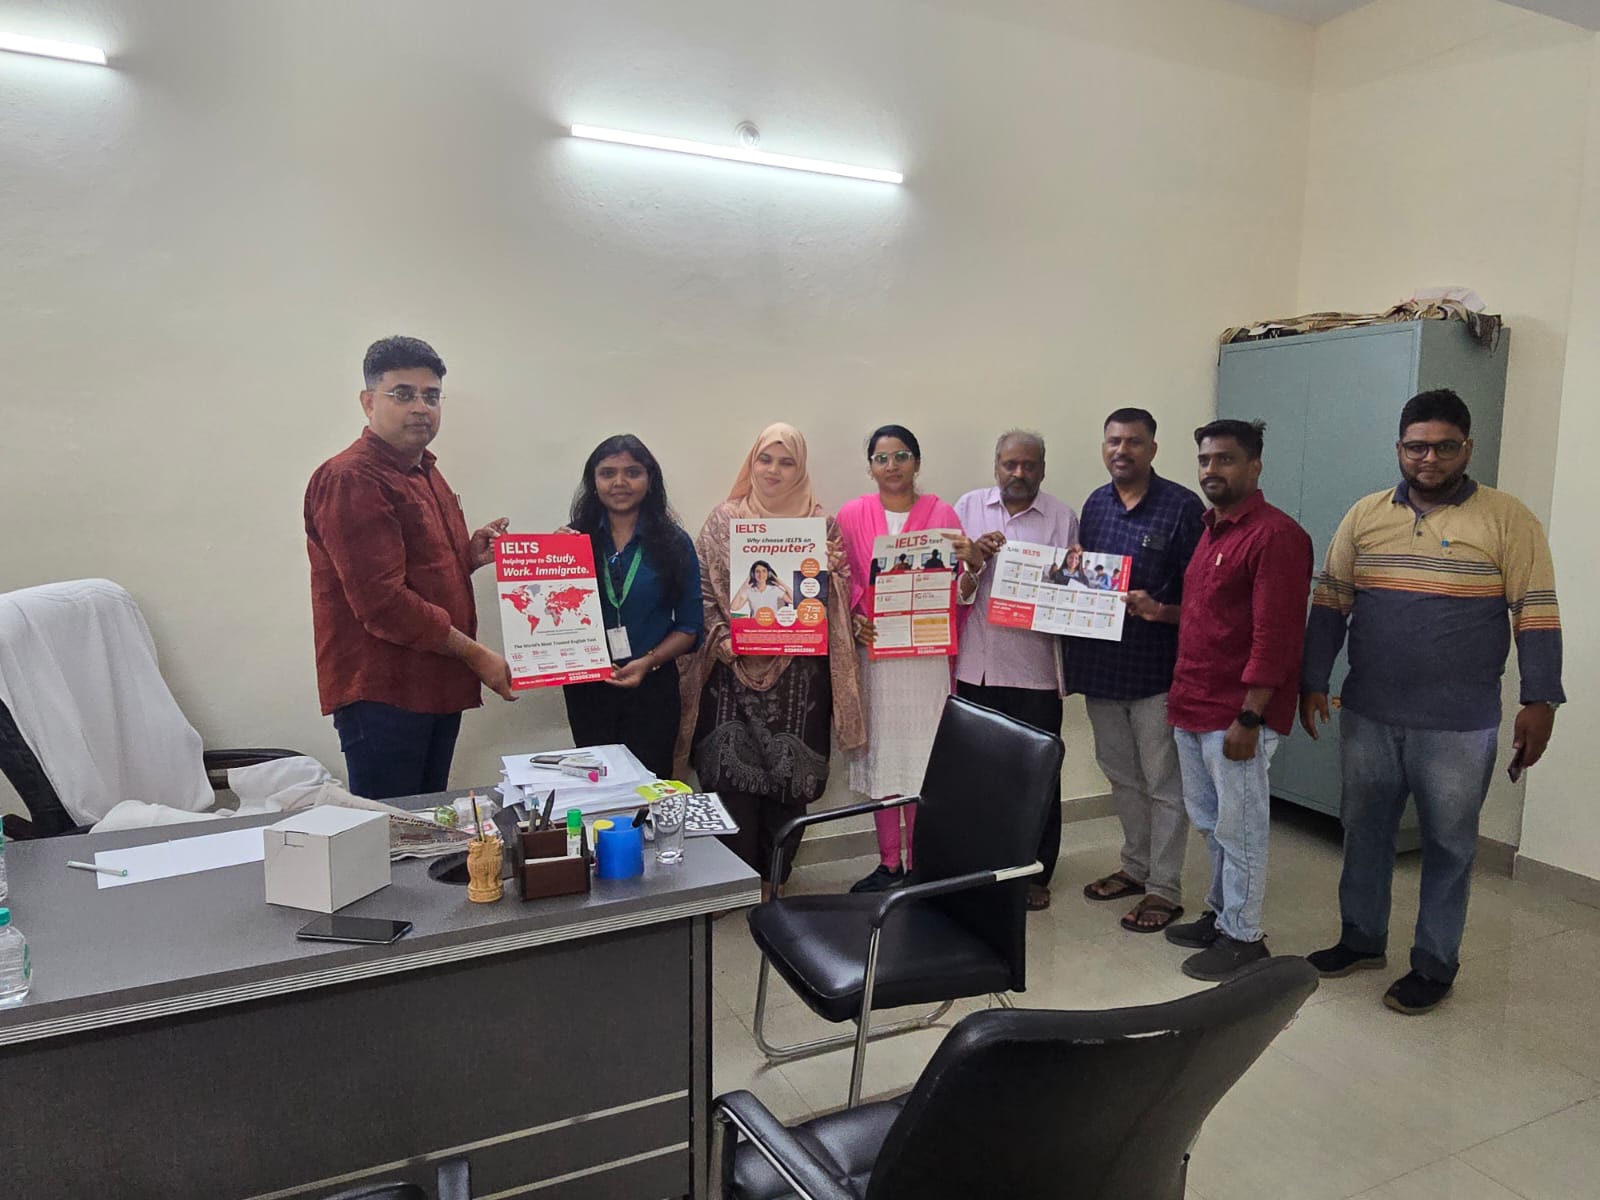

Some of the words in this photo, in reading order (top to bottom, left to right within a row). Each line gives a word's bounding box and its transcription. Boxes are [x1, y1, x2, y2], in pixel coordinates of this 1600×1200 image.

[736, 524, 766, 533] IELTS
[895, 534, 928, 549] IELTS
[501, 542, 539, 554] IELTS
[743, 543, 816, 555] computer?
[1022, 548, 1040, 557] IELTS
[503, 558, 524, 566] helping
[546, 553, 576, 565] Study.
[503, 567, 533, 577] Work.
[535, 565, 589, 576] Immigrate.
